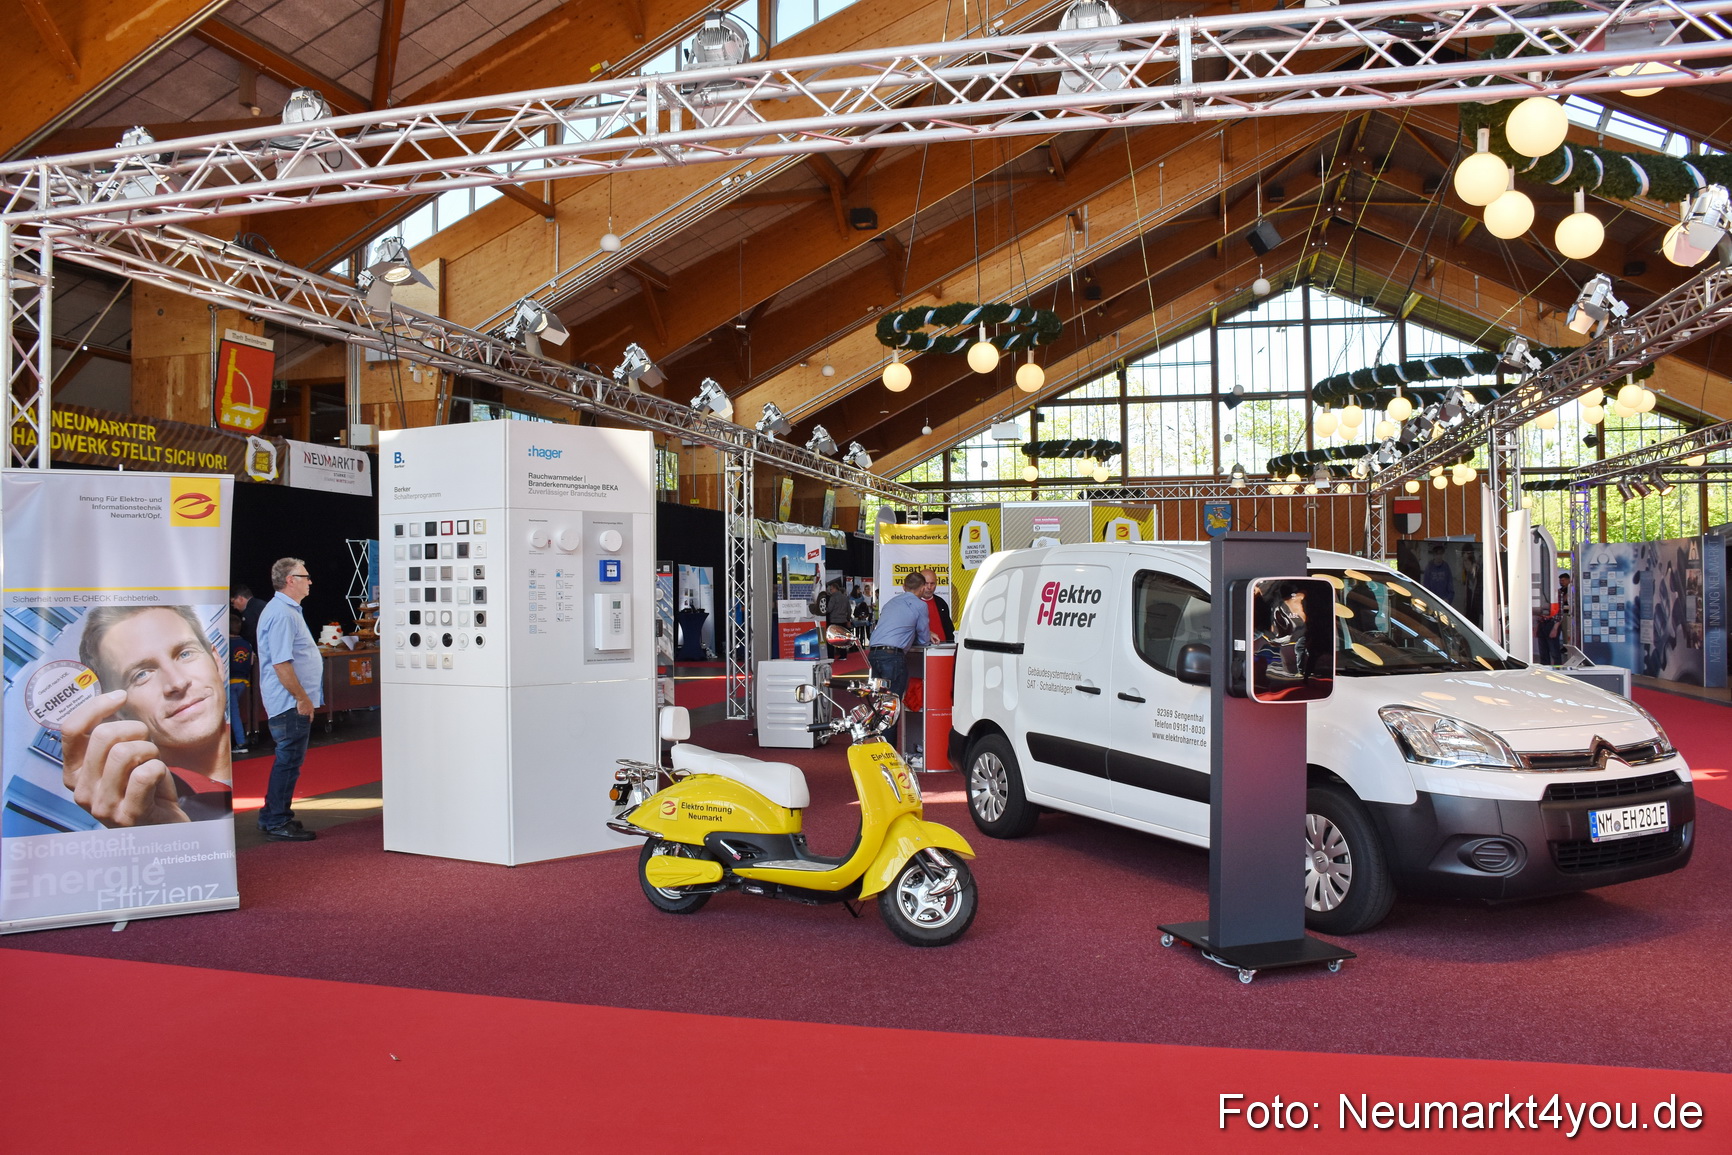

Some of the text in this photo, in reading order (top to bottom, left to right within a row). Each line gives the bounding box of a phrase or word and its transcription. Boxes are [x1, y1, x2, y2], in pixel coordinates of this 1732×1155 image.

[51, 409, 156, 442] NEUMARKTER
[14, 427, 228, 470] HADWERK STELLT SICH VOR!
[303, 451, 356, 471] NEUMARKT
[528, 472, 583, 482] Rauchwarnmelder
[528, 480, 619, 491] Branderkennungsanlage BEKA
[528, 488, 607, 498] Zuverlässiger Brandschutz
[79, 495, 104, 503] Innung
[119, 495, 148, 503] Elektro-
[394, 492, 442, 500] Schalterprogramm
[91, 503, 162, 511] Informationstechnik
[894, 564, 922, 573] Smart
[12, 595, 52, 603] Sicherheit
[73, 594, 112, 602] E-CHECK
[113, 593, 161, 602] Fachbetrieb.
[1041, 581, 1102, 605] Elektro
[1036, 602, 1097, 628] Harrer
[1027, 666, 1082, 681] Gebäudesystemtechnik
[1026, 679, 1073, 695] SAT Schaltanlagen
[34, 682, 79, 719] E-CHECK
[1174, 710, 1205, 723] Sengenthal
[1154, 719, 1206, 735] Telefon 09181-8030
[1151, 732, 1208, 748] www.elektroharrer.de
[870, 752, 895, 762] Elektro
[681, 801, 733, 815] Elektro Innung
[688, 812, 723, 822] Neumarkt
[10, 832, 200, 861] Sicherheit Kommunikation
[152, 849, 236, 867] Antriebstechnik
[4, 857, 166, 899] Energie
[97, 882, 220, 911] Effizienz
